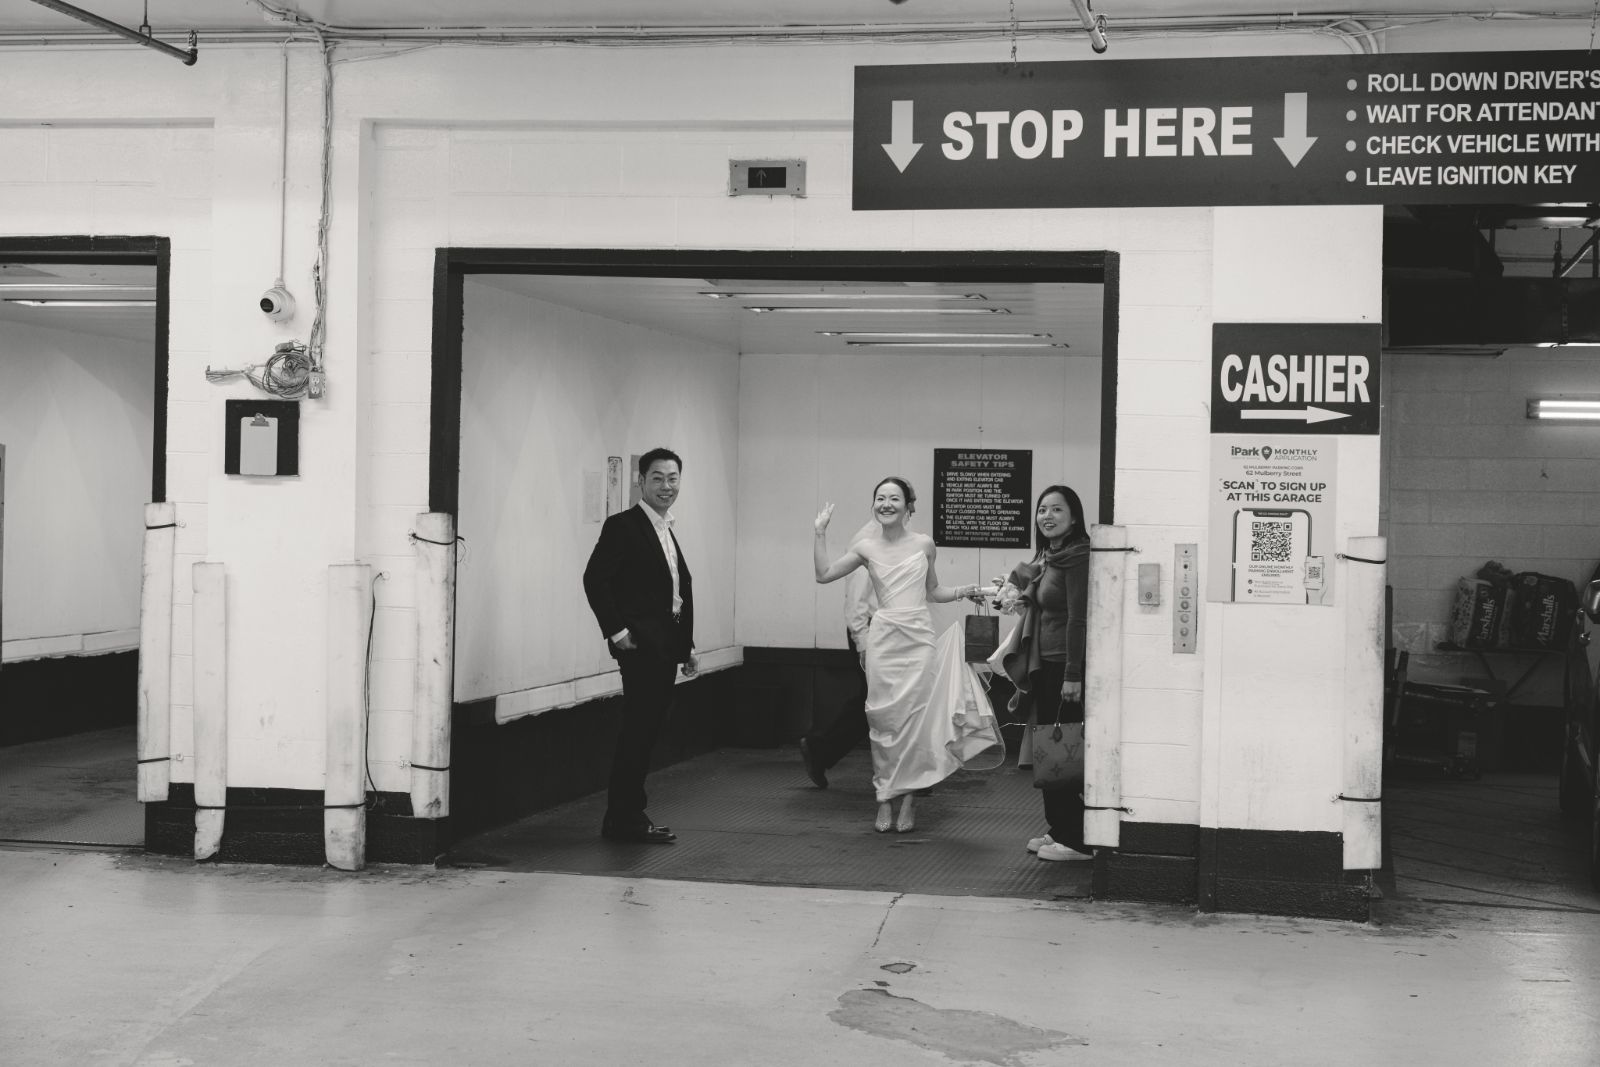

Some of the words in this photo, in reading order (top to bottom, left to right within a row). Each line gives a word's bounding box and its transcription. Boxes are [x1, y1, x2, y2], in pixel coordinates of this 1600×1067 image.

[1368, 74, 1424, 92] ROLL
[1431, 72, 1497, 91] DOWN
[1504, 70, 1600, 89] DRIVER'S
[1366, 104, 1420, 123] WAIT
[1427, 104, 1472, 122] FOR
[941, 110, 1084, 160] STOP
[1104, 106, 1253, 157] HERE
[1366, 135, 1441, 154] CHECK
[1447, 134, 1539, 153] VEHICLE
[1546, 133, 1600, 152] WITH
[1366, 167, 1431, 185] LEAVE
[1438, 166, 1527, 184] IGNITION
[1534, 165, 1576, 184] KEY
[1220, 354, 1370, 402] CASHIER
[1232, 446, 1259, 456] iPark
[1223, 481, 1254, 490] SCAN
[1261, 482, 1276, 490] TO
[1280, 482, 1306, 490] SIGN
[1310, 483, 1326, 491] UP
[1245, 493, 1270, 501] THIS
[1273, 494, 1322, 502] GARAGE
[1476, 599, 1495, 641] arshalls
[1537, 594, 1555, 646] Marshalls
